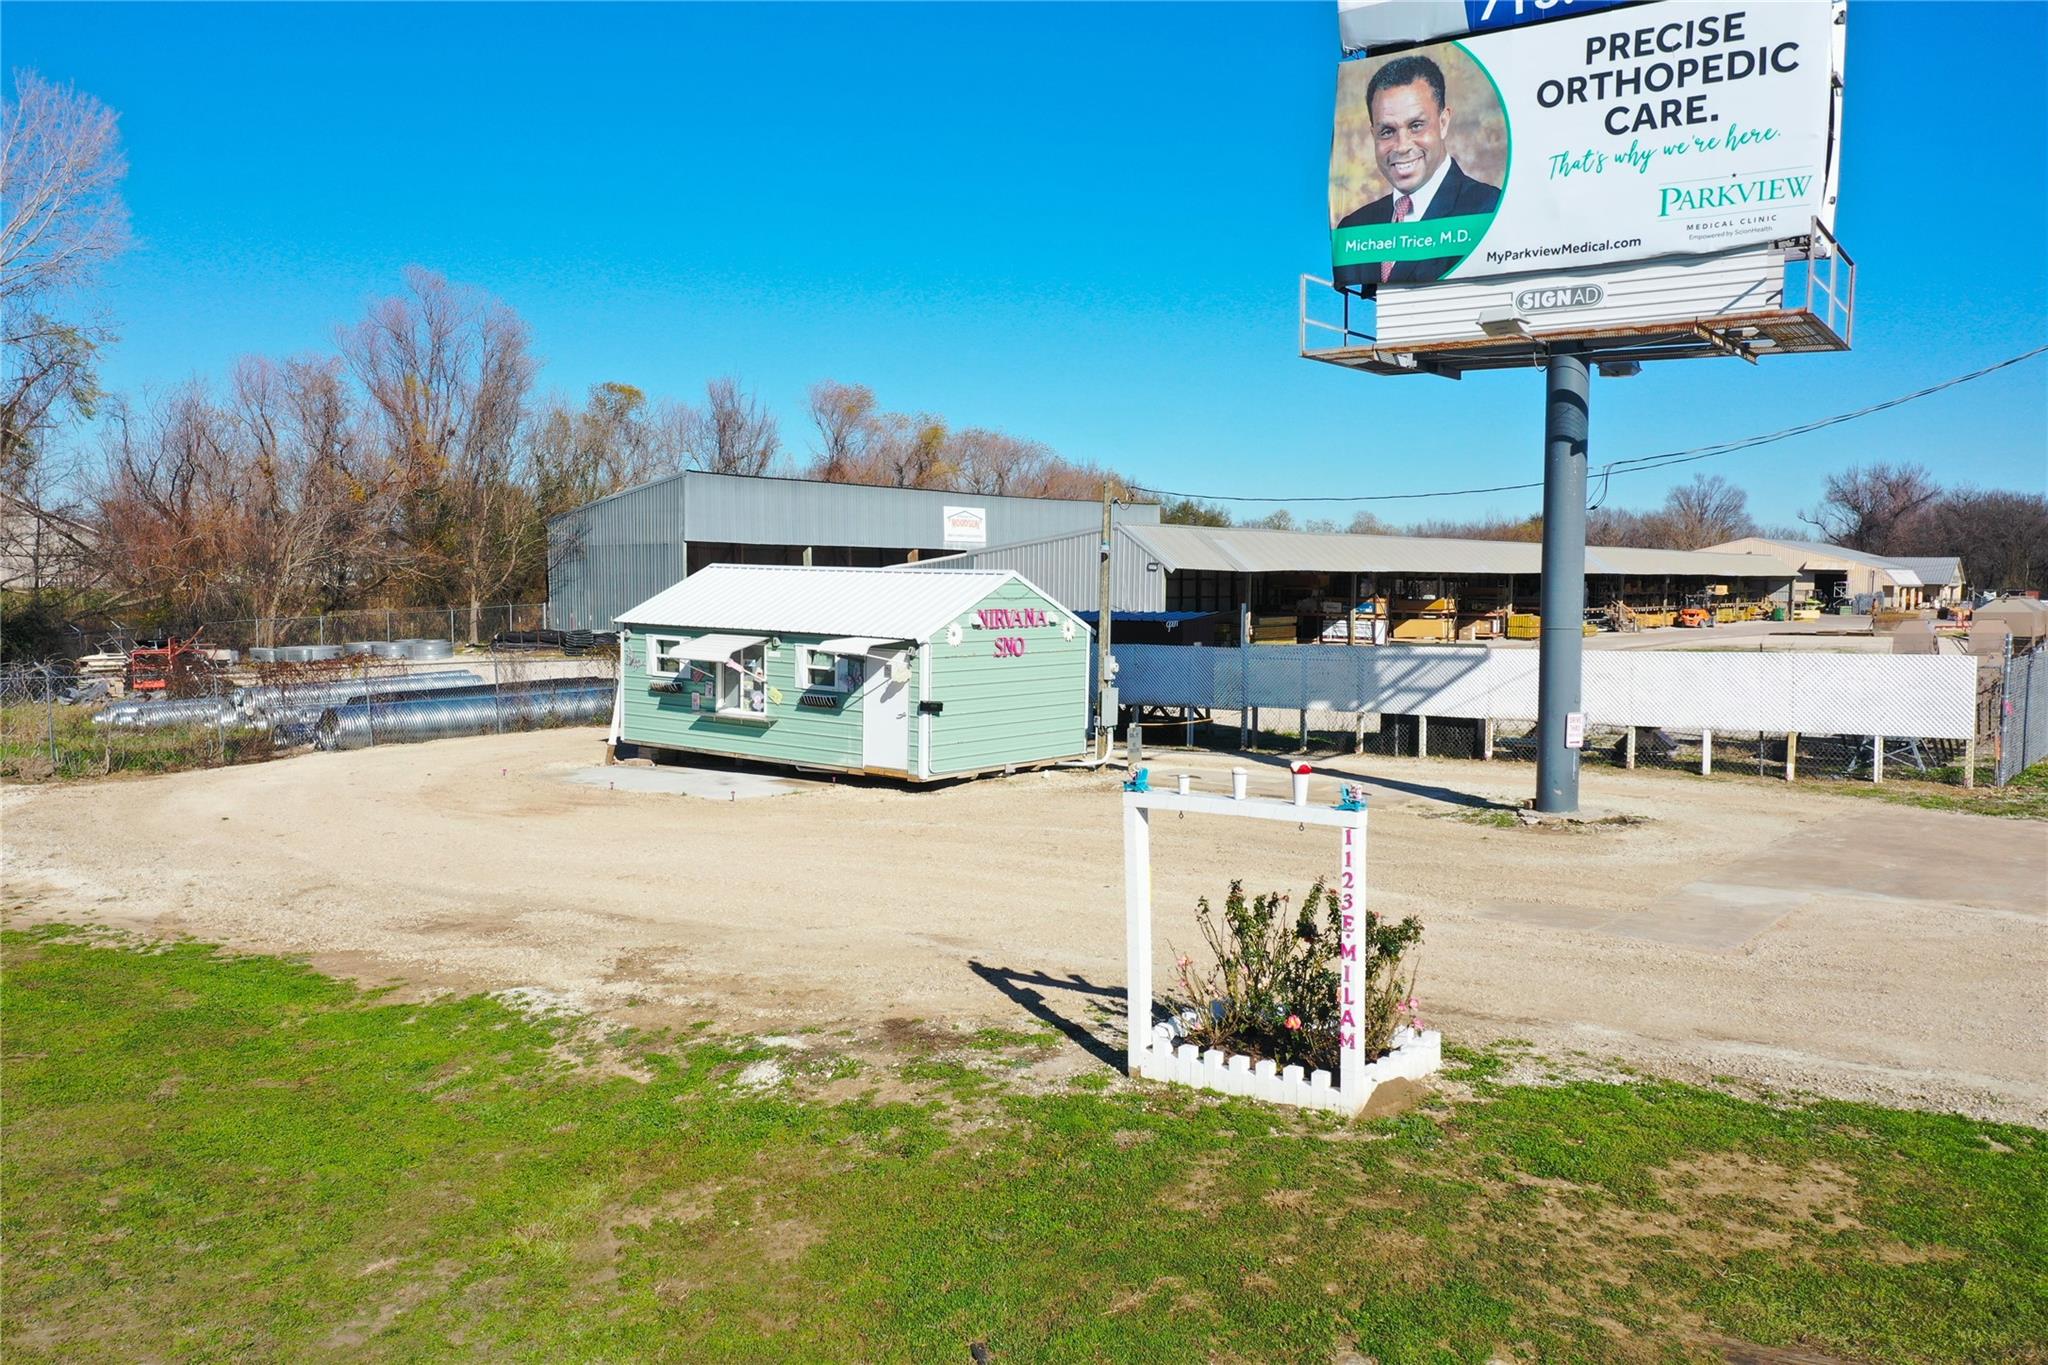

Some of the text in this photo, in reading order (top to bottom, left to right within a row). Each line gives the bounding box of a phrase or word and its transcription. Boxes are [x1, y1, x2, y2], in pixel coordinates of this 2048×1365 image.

[1586, 11, 1746, 65] PRECISE
[1537, 42, 1800, 108] ORTHOPEDIC
[1604, 95, 1719, 136] CARE.
[1548, 123, 1782, 180] That's why we're here.
[1686, 214, 1778, 231] MEDICAL CLINIC
[1345, 229, 1472, 252] Michael Trice, M.D.
[1486, 236, 1642, 264] MyParkviewMedical.com
[977, 608, 1048, 630] NIRVANA
[993, 637, 1026, 658] SNO
[1338, 943, 1356, 1050] MILAM
